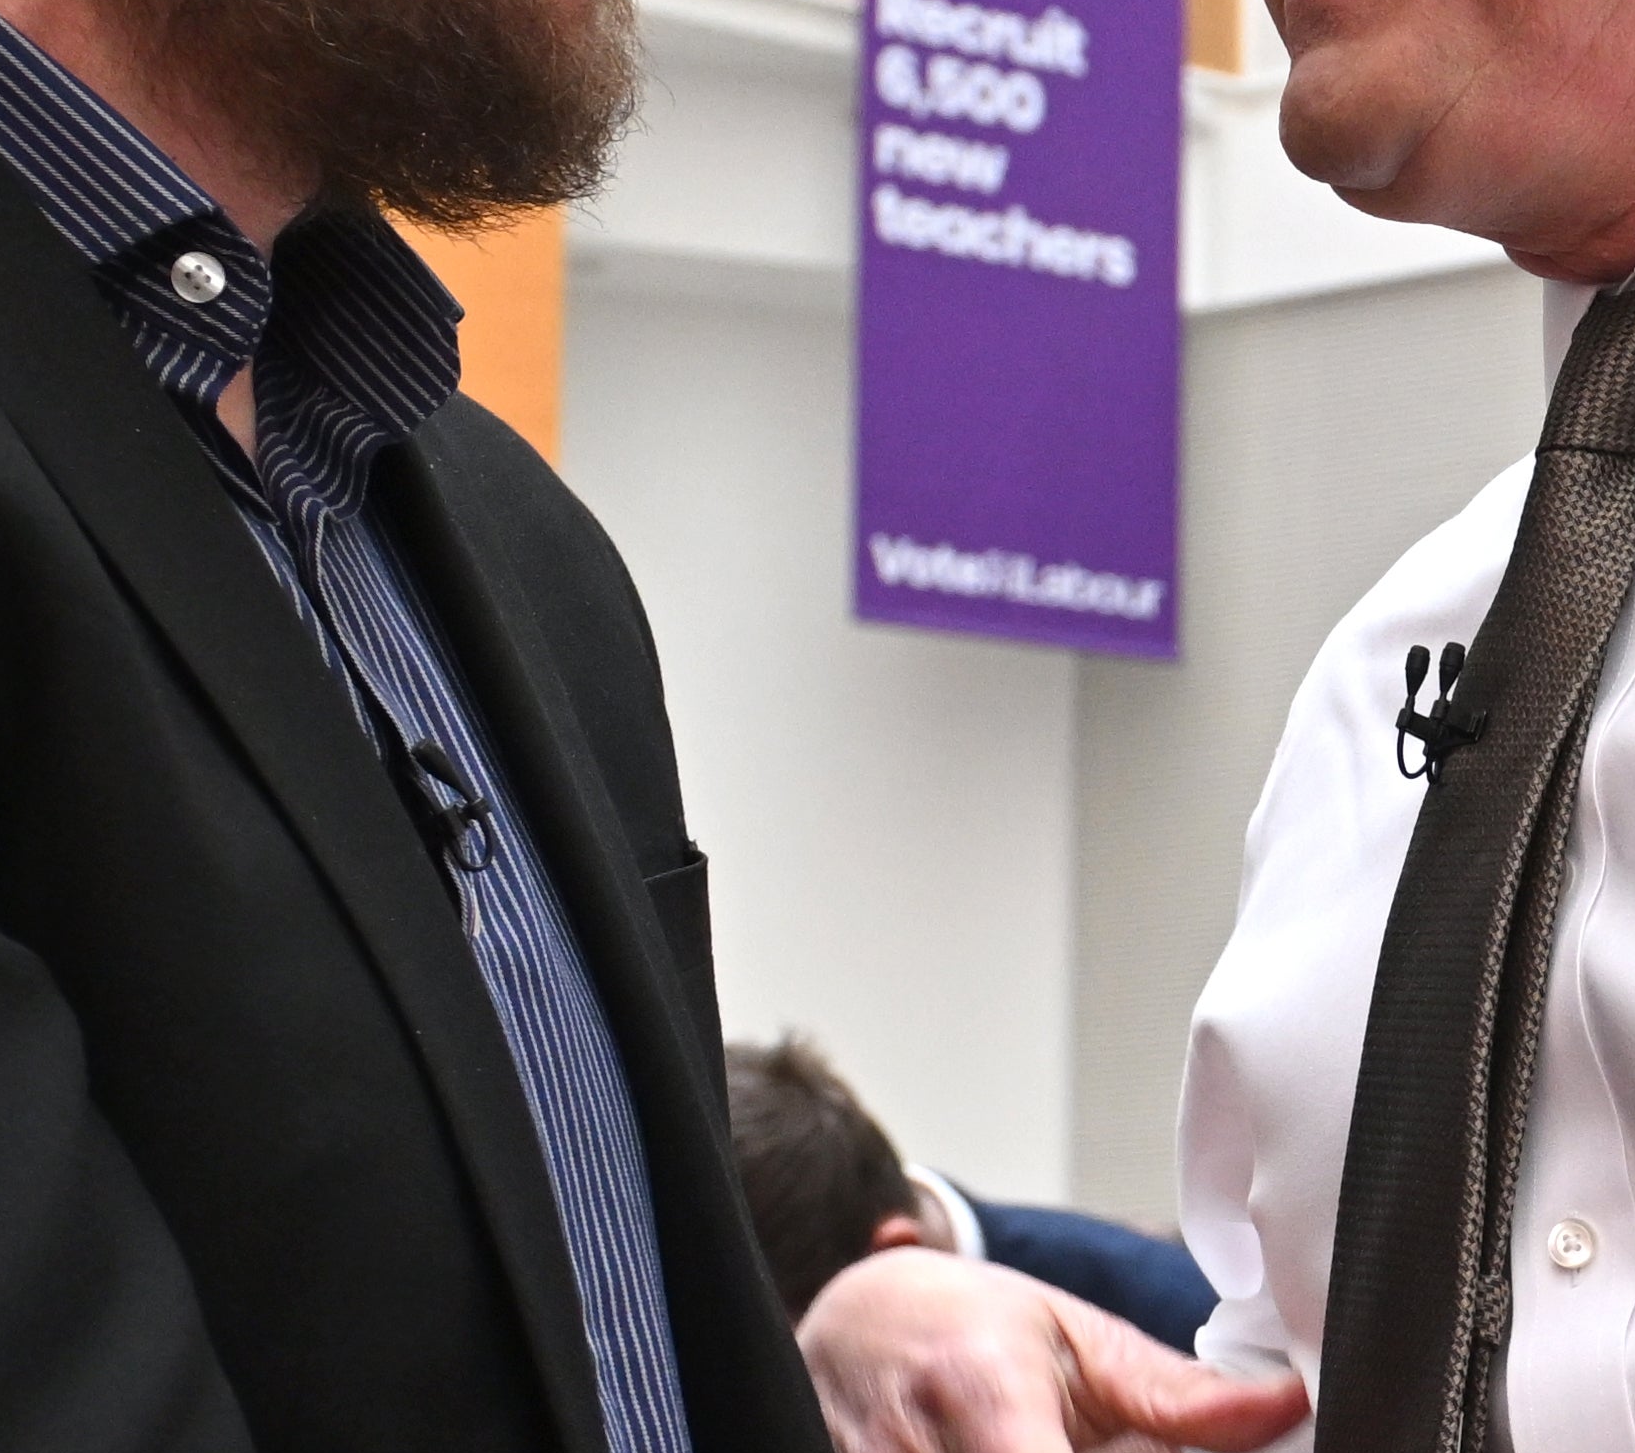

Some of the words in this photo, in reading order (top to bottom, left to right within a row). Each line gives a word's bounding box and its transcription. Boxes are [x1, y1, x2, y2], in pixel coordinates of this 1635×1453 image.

[875, 44, 1047, 134] 6,500
[873, 123, 1010, 194] new
[872, 183, 1138, 288] teachers
[869, 532, 978, 598] Vote
[1005, 551, 1165, 622] Labour
